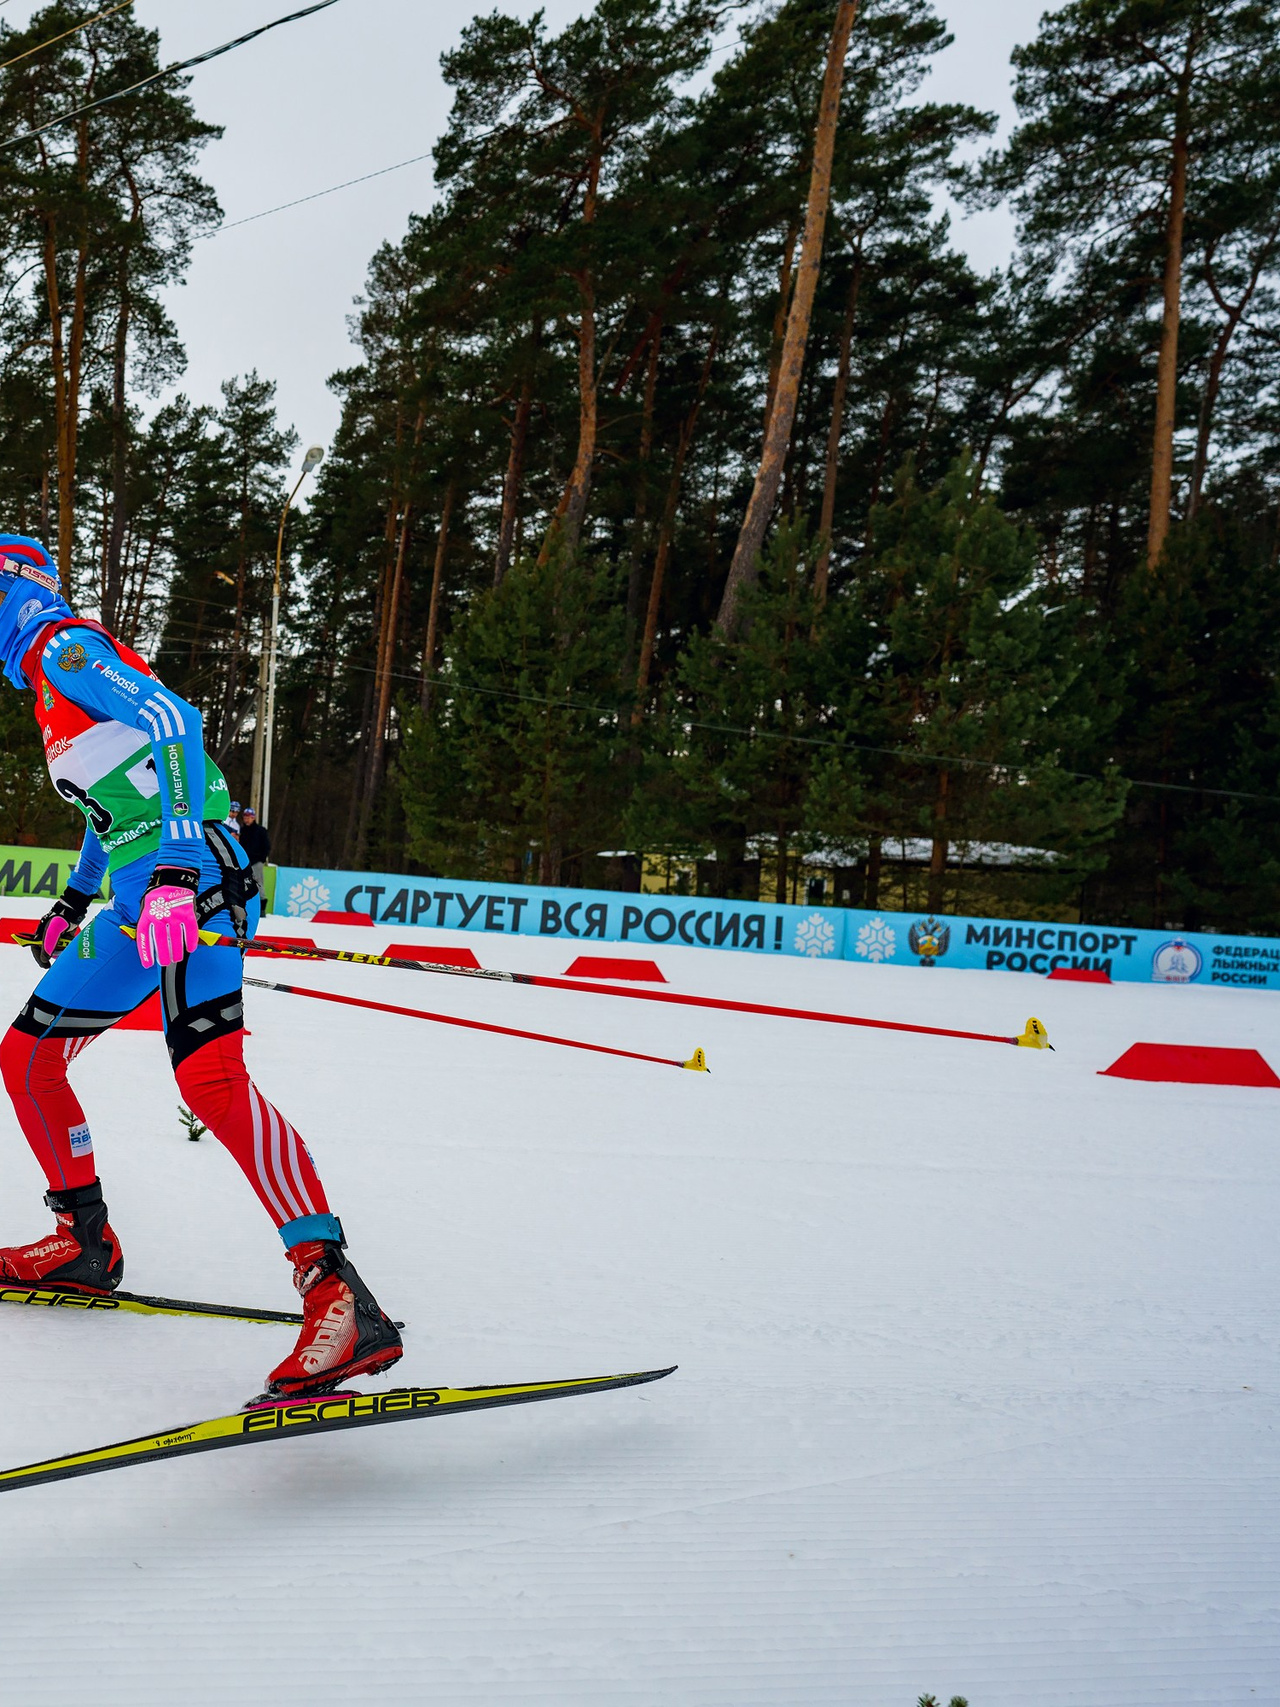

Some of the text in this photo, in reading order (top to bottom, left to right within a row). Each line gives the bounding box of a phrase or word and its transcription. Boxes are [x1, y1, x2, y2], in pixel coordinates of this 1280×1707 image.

[91, 659, 140, 695] Webasto
[168, 744, 184, 800] МЕГАФОН
[344, 885, 783, 950] СТАРТУЕТ ВСЯ РОССИЯ!
[965, 924, 1137, 956] МИНСПОРТ
[337, 951, 391, 966] LEKI
[986, 950, 1113, 978] РОССИИ
[1212, 958, 1280, 973] ЛЫЖНЫХ
[1211, 972, 1268, 985] РОССИИ
[23, 1238, 73, 1258] alpina
[298, 1282, 355, 1374] alpina
[242, 1391, 441, 1434] FISCHER
